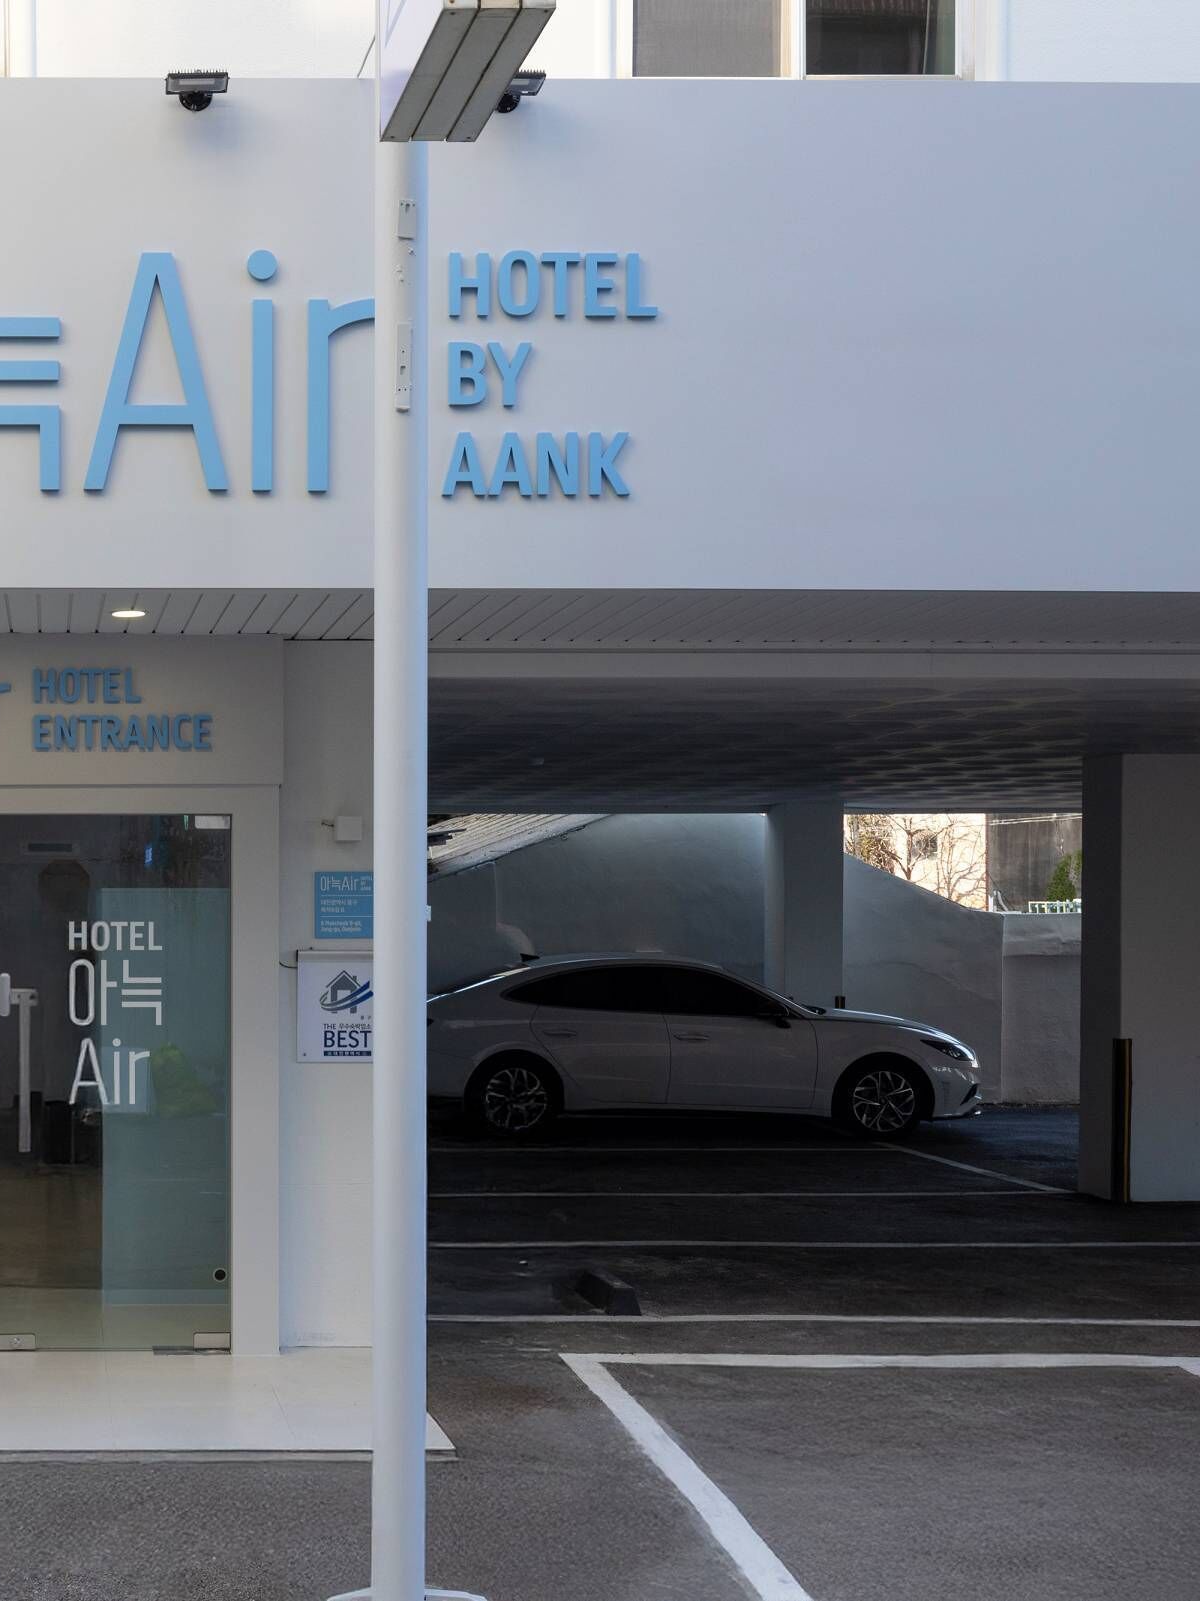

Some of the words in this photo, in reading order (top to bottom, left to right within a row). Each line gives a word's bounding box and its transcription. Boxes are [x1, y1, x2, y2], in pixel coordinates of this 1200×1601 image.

[448, 250, 660, 318] HOTEL
[447, 341, 533, 408] BY
[442, 431, 631, 497] AANK
[33, 667, 140, 703] HOTEL
[33, 714, 211, 751] ENTRANCE
[68, 921, 163, 951] HOTEL
[68, 959, 163, 1026] 아늑
[69, 1038, 151, 1106] Air
[323, 1030, 372, 1048] BEST
